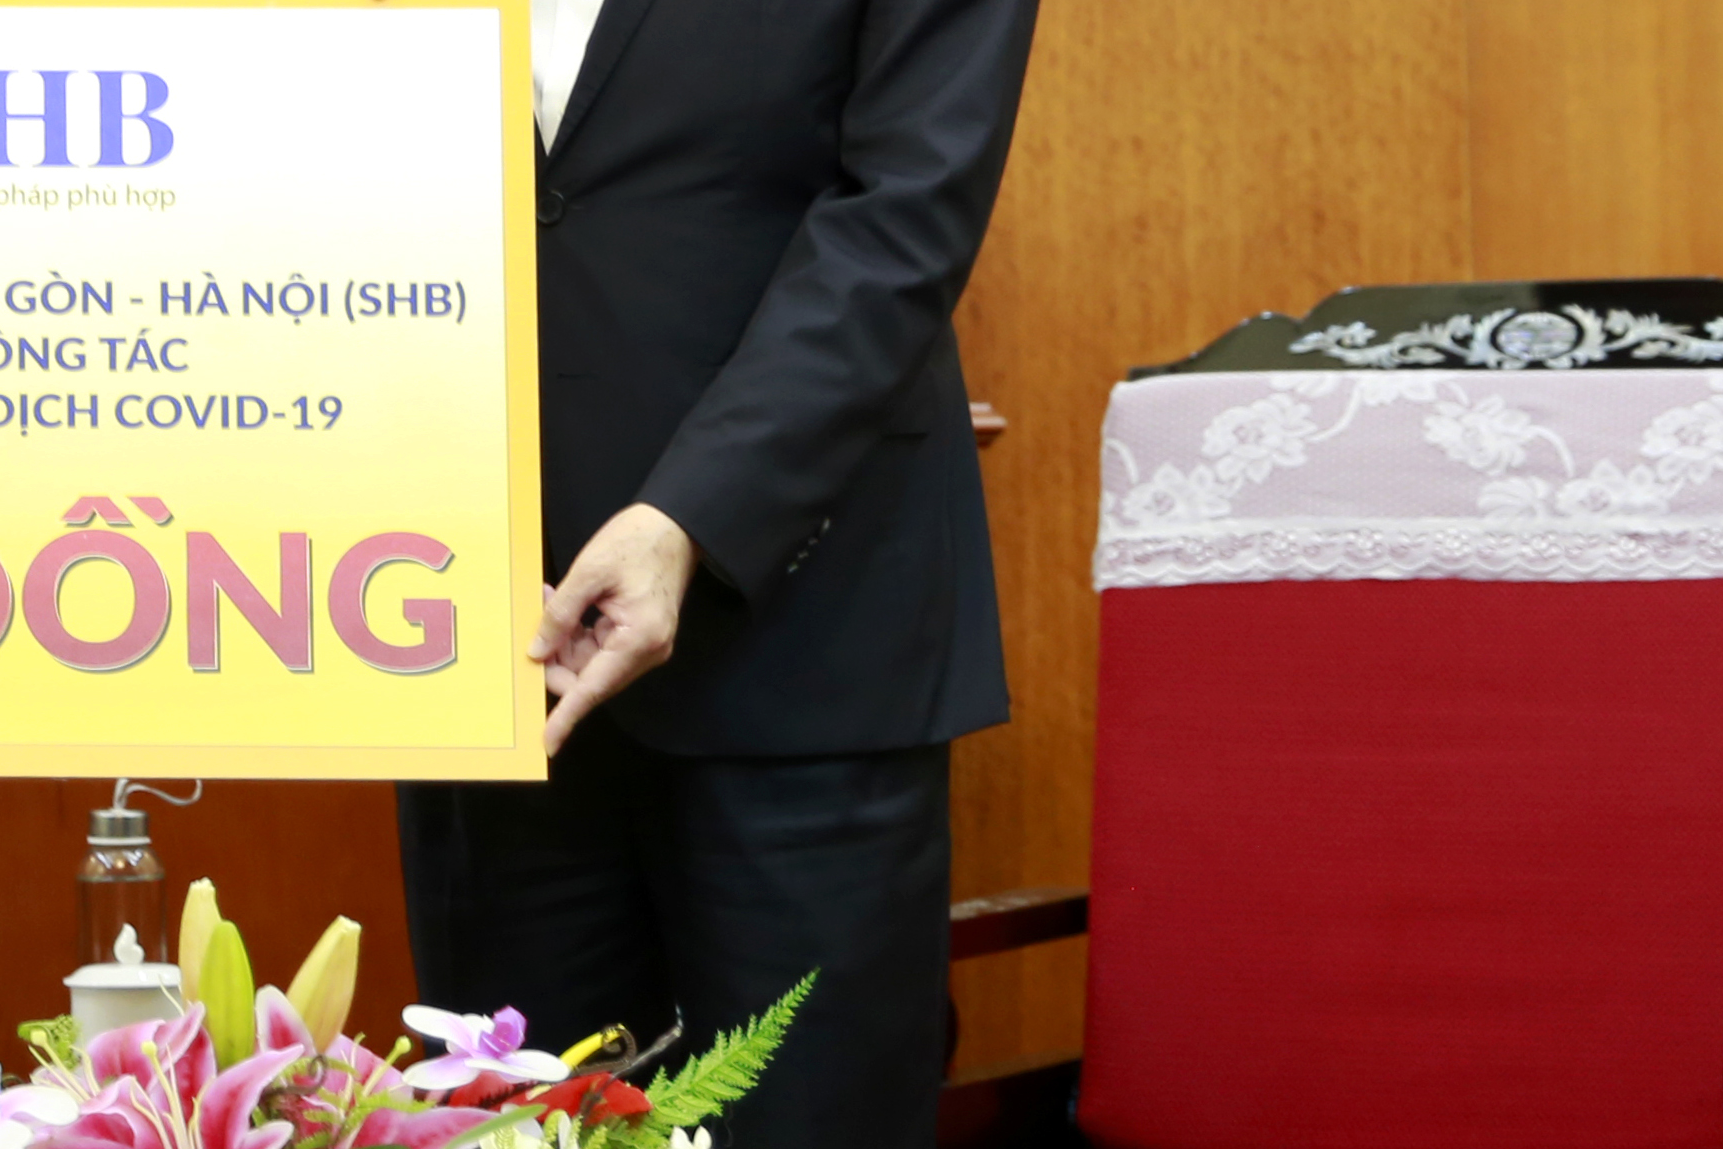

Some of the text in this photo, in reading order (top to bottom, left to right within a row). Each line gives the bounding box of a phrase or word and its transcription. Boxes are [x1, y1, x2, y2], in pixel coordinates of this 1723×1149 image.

[68, 184, 116, 211] phù
[126, 184, 176, 212] hợp
[4, 270, 114, 316] GÒN
[160, 271, 229, 317] HÀ
[242, 273, 329, 326] NỘI
[343, 280, 466, 324] (SHB)
[99, 328, 189, 372] TÁC
[114, 394, 345, 431] COVID-19
